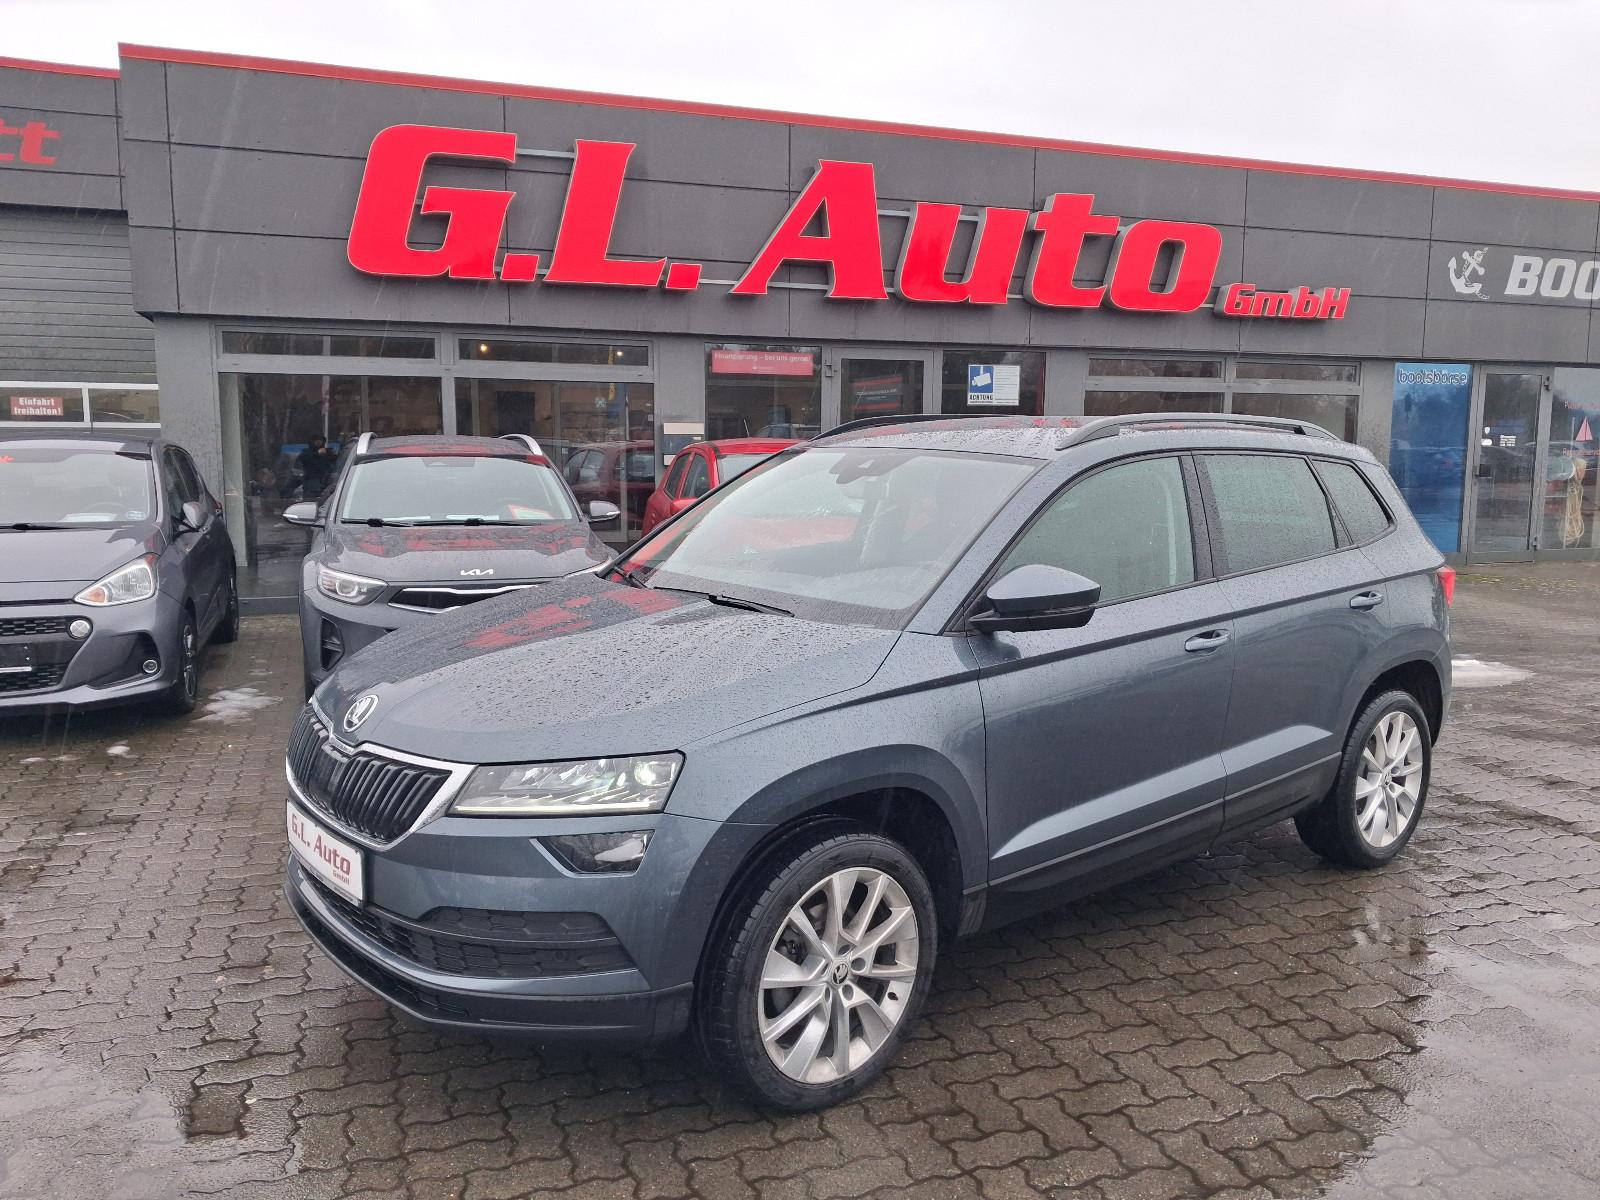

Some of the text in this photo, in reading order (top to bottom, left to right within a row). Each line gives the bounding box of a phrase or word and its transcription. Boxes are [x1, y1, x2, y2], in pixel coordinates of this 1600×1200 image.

[728, 159, 1222, 313] Auto
[1218, 282, 1351, 319] GmbH
[714, 352, 758, 362] Finanzierung
[19, 397, 55, 406] Einfahrt
[14, 406, 61, 416] freihalten!
[313, 834, 351, 876] Auto
